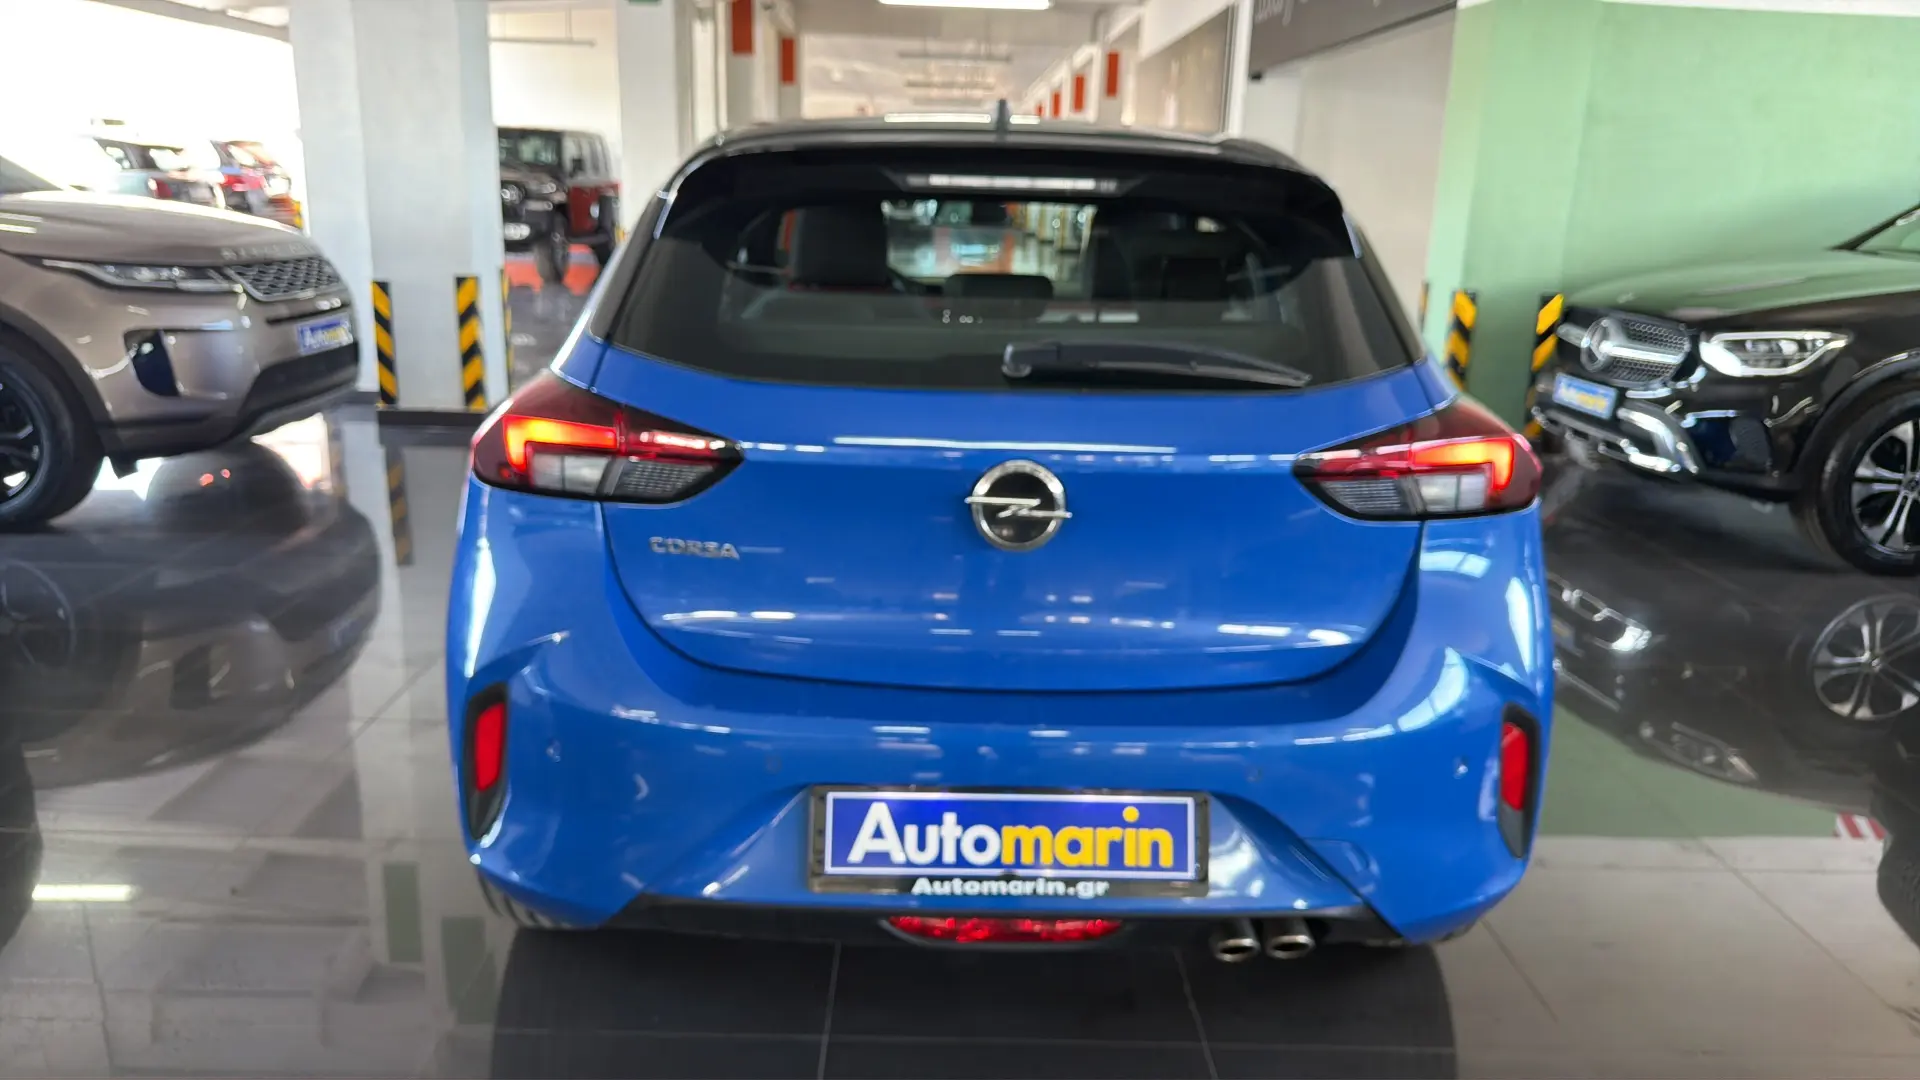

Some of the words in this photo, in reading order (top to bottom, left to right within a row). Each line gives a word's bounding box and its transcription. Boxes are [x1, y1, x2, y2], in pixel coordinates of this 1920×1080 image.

[649, 536, 740, 560] CORSA
[847, 802, 1174, 868] Automarin
[910, 877, 1110, 899] Automarin.gr
